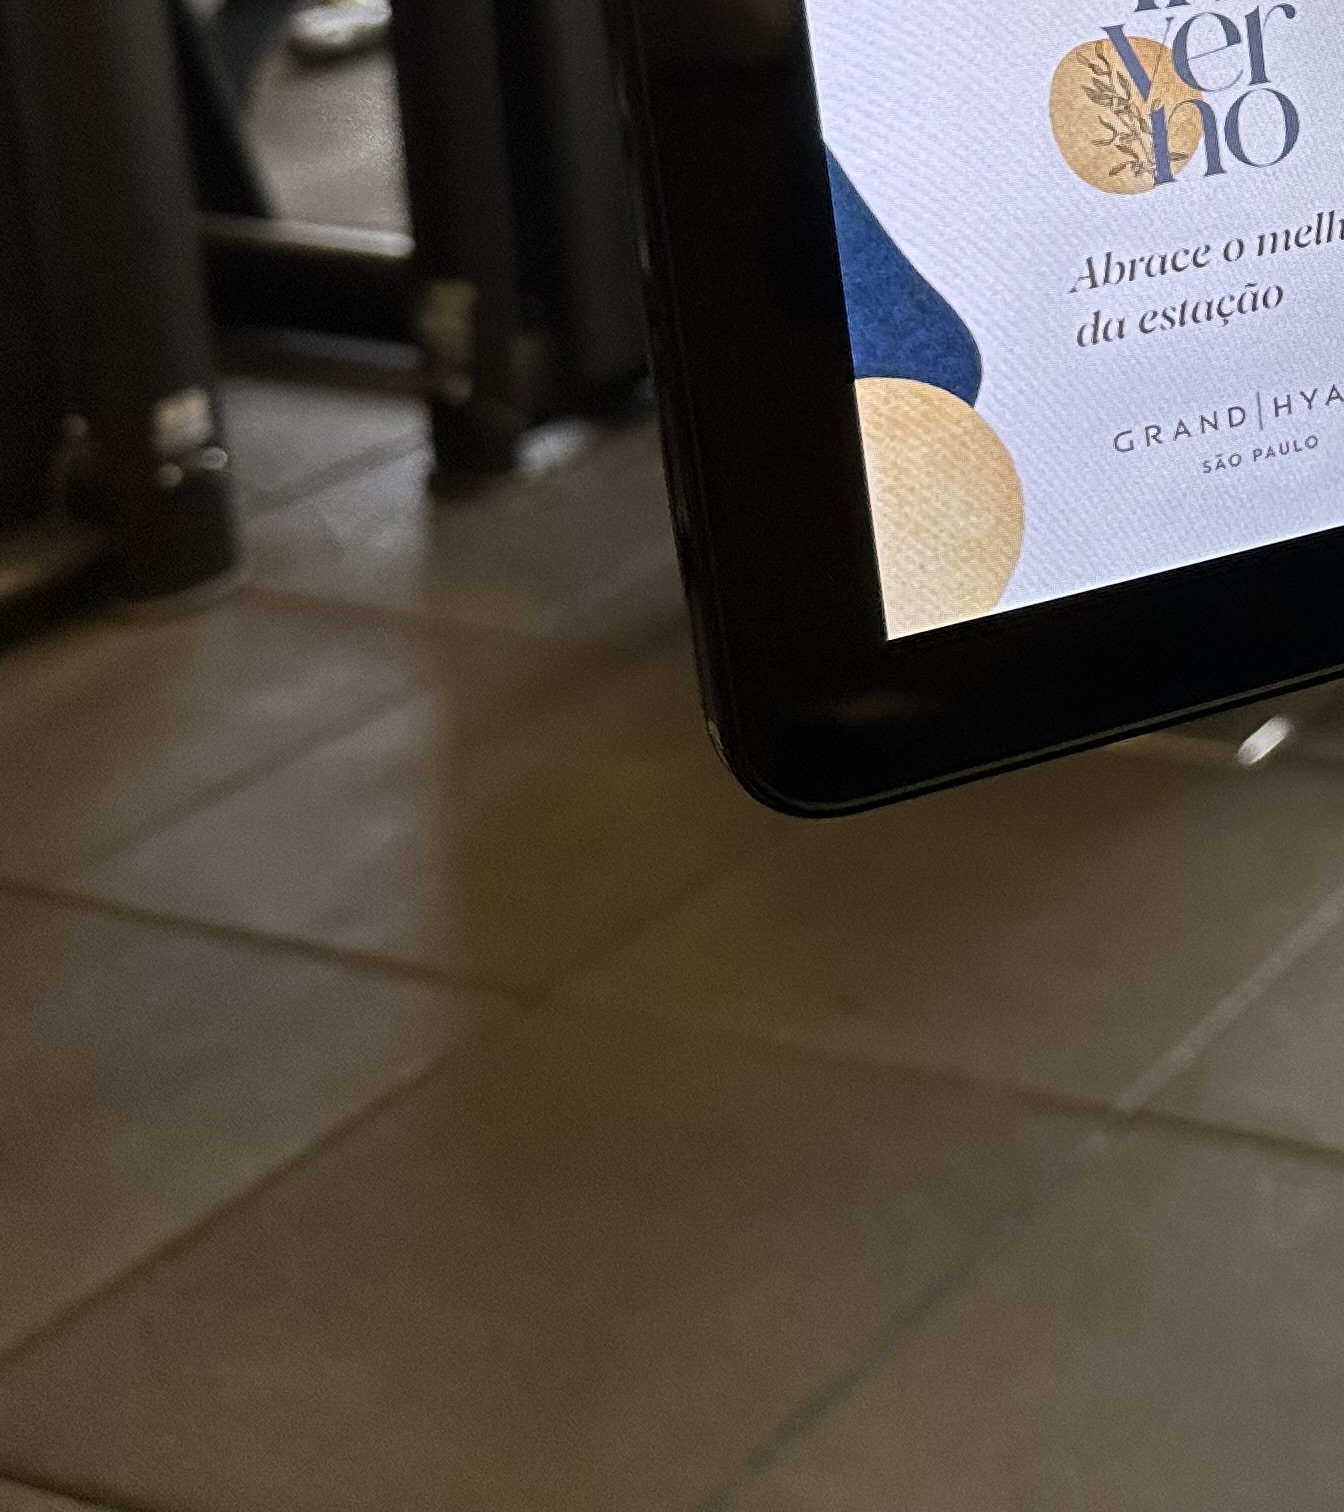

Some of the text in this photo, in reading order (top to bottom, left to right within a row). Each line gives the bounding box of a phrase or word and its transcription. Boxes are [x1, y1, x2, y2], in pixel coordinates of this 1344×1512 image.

[1100, 3, 1296, 102] ver
[1150, 88, 1299, 185] no
[1067, 243, 1211, 293] Abrace
[1223, 238, 1244, 262] o
[1076, 283, 1284, 347] da estação
[1113, 406, 1247, 453] GRAND
[1202, 435, 1318, 474] SÃO PAULO
